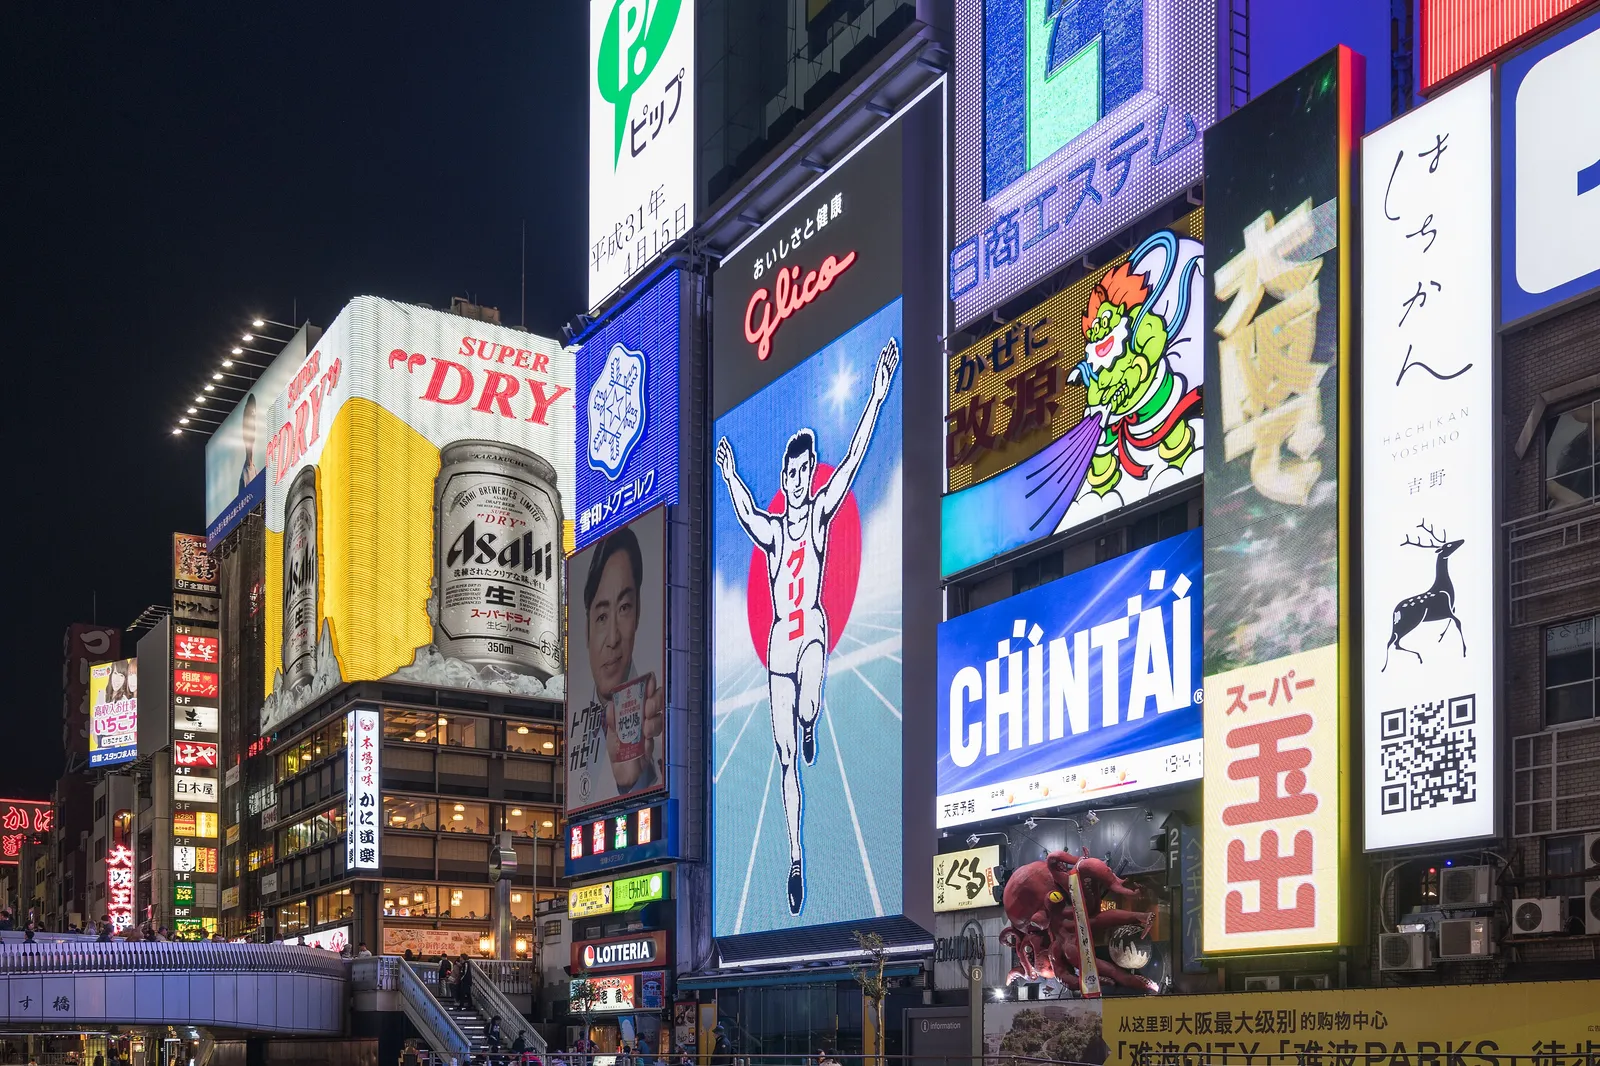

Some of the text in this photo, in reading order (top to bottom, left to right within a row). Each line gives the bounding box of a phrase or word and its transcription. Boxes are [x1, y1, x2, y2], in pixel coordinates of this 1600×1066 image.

[631, 67, 685, 158] ピップ
[950, 103, 1198, 301] 日商エステム
[591, 184, 666, 272] 平成31年
[753, 192, 842, 280] おいしさと健康
[1385, 133, 1474, 387] はちかん
[744, 251, 857, 361] Glico
[287, 350, 320, 409] SUPER
[458, 336, 550, 375] SUPER
[955, 318, 1051, 394] かぜに
[1383, 407, 1469, 446] HACHIKAN
[1391, 430, 1460, 462] YOSHINO
[459, 485, 541, 522] ASAHI BREWERIES LIMITED
[580, 469, 655, 534] 雪印メグミルク
[1408, 468, 1446, 495] 吉野
[490, 508, 511, 517] SUPER
[286, 541, 315, 609] Asahi
[447, 520, 552, 581] Asahi
[485, 586, 516, 608] 生
[786, 540, 807, 641] グリコ
[471, 609, 531, 626] スーパードライ
[488, 642, 514, 655] 350ml
[175, 681, 218, 695] ダイニング
[1226, 670, 1316, 716] スーパー
[360, 735, 374, 787] 本場の味
[177, 780, 214, 795] 白木屋
[359, 791, 375, 863] かに道楽
[1221, 713, 1319, 935] 玉出
[945, 856, 986, 900] くくる
[596, 941, 650, 963] LOTTERIA
[930, 1020, 961, 1031] information
